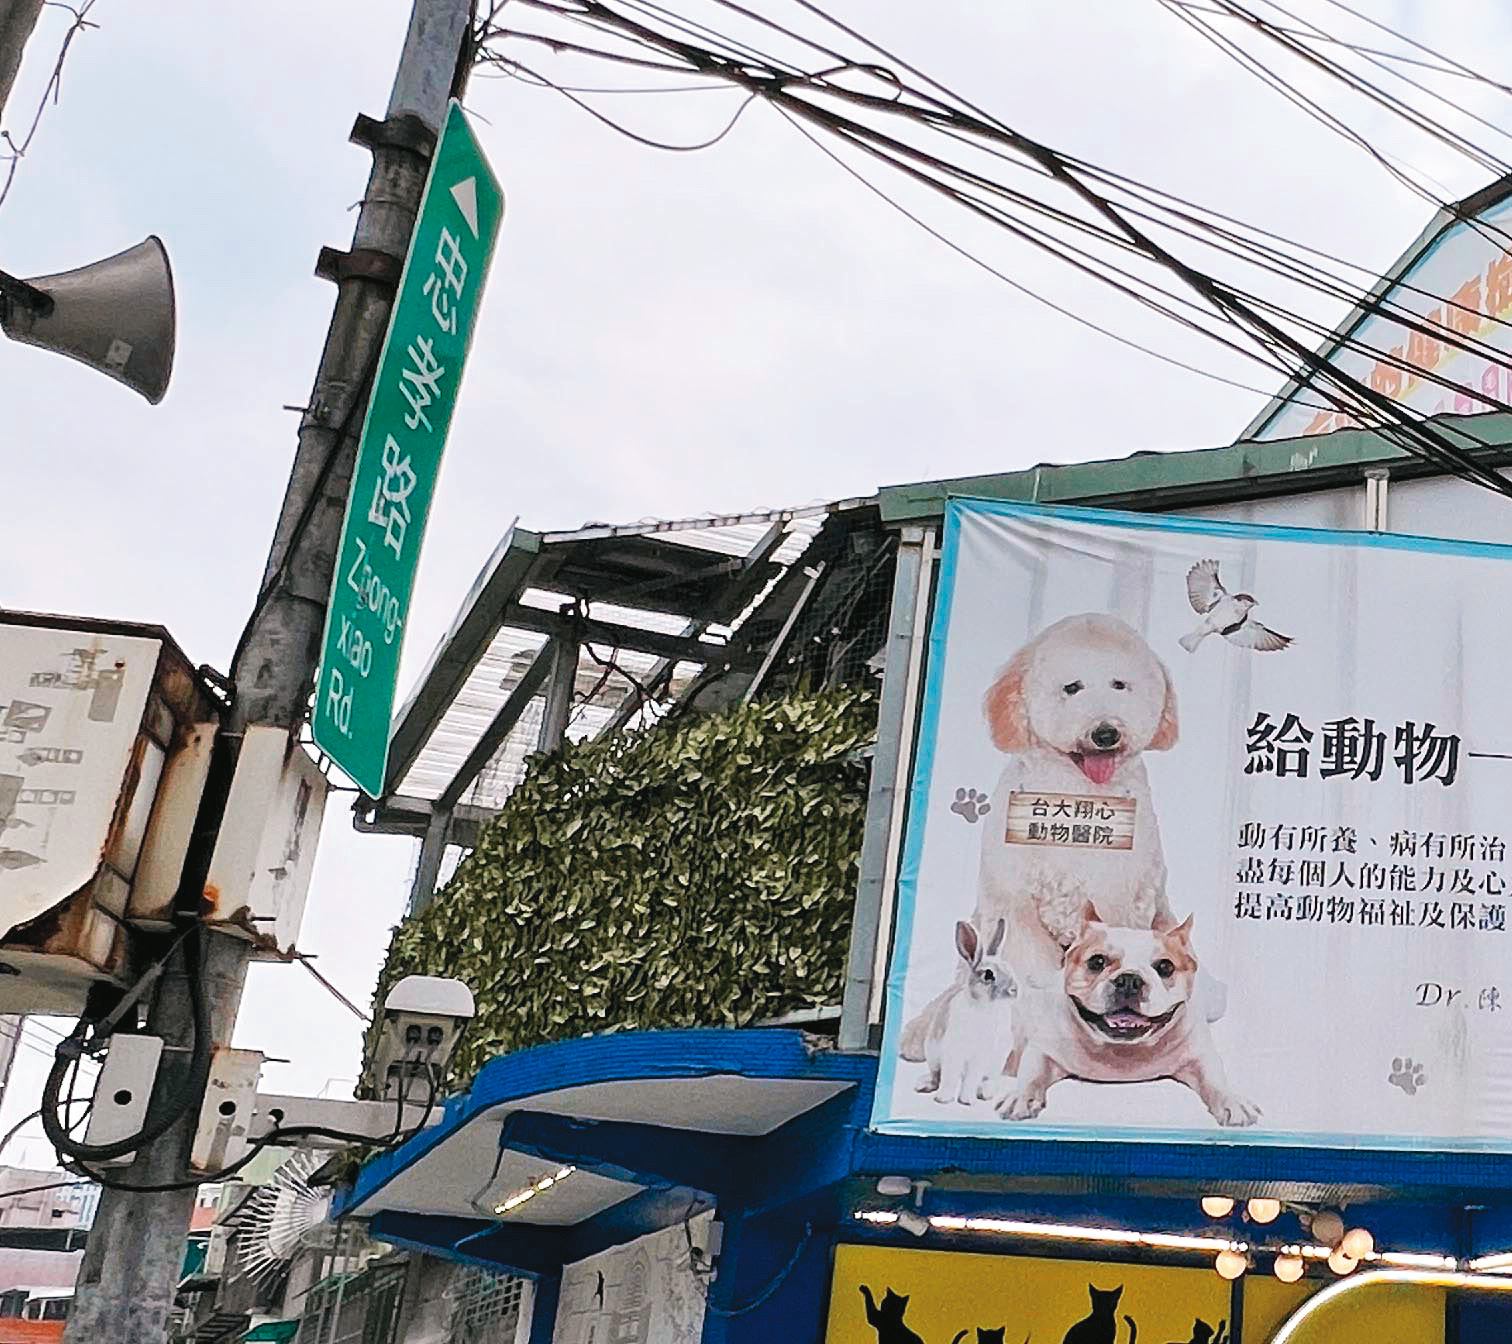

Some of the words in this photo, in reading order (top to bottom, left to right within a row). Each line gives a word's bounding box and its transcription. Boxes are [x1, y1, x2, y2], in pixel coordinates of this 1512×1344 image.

[368, 227, 467, 560] 忠孝路
[337, 614, 371, 677] xiao
[326, 668, 353, 739] Rd.
[1027, 822, 1113, 845] 動物醫院
[1031, 798, 1115, 820] 台大翔心
